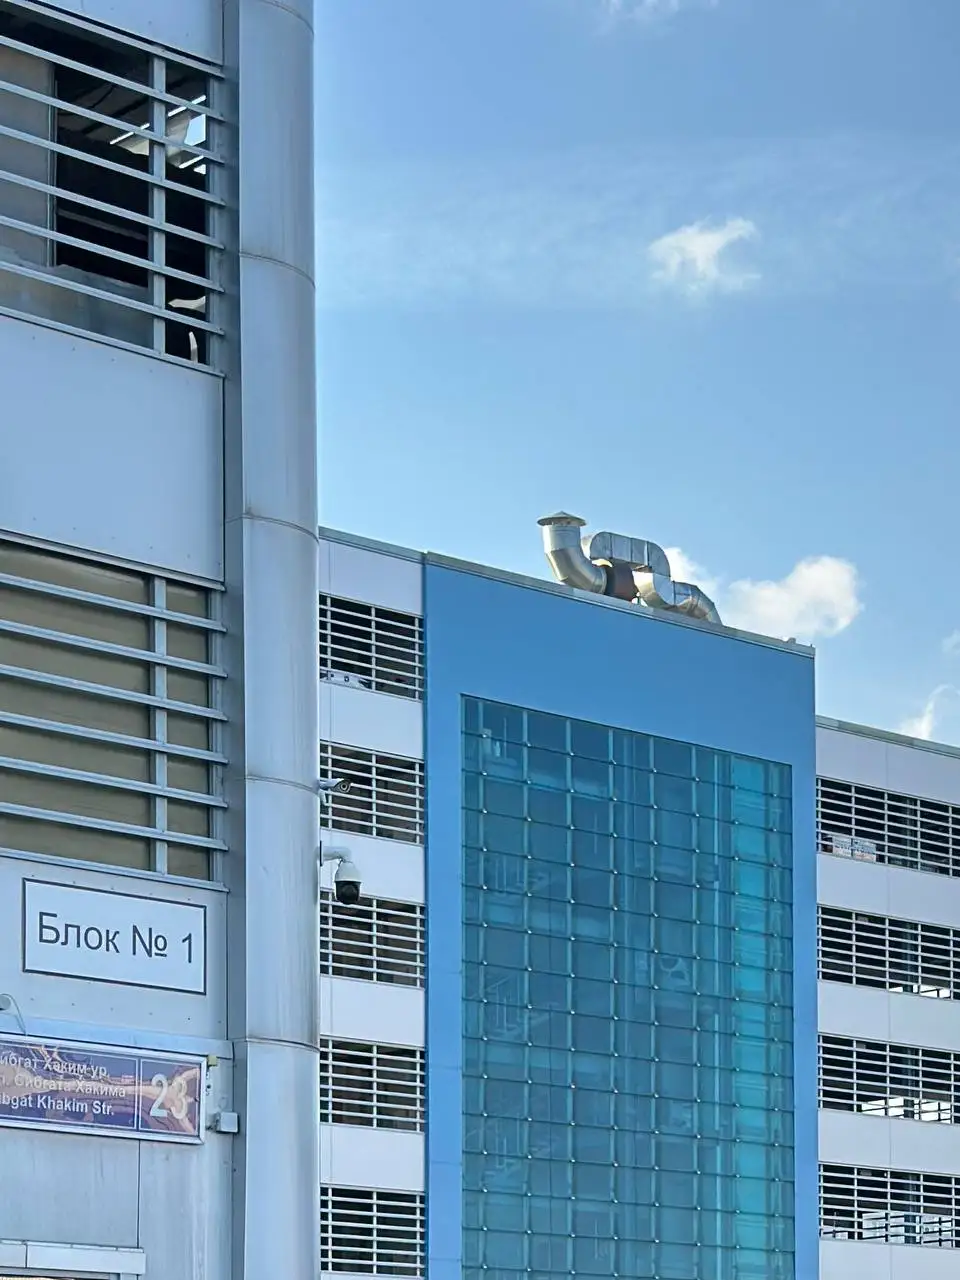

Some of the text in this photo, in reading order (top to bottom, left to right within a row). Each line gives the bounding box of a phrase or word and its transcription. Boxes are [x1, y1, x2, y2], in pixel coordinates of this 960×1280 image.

[38, 911, 193, 964] Блок № 1
[37, 1094, 89, 1113] Khakim
[92, 1100, 115, 1116] Str.
[75, 1081, 126, 1098] Хакима
[149, 1073, 189, 1120] 23
